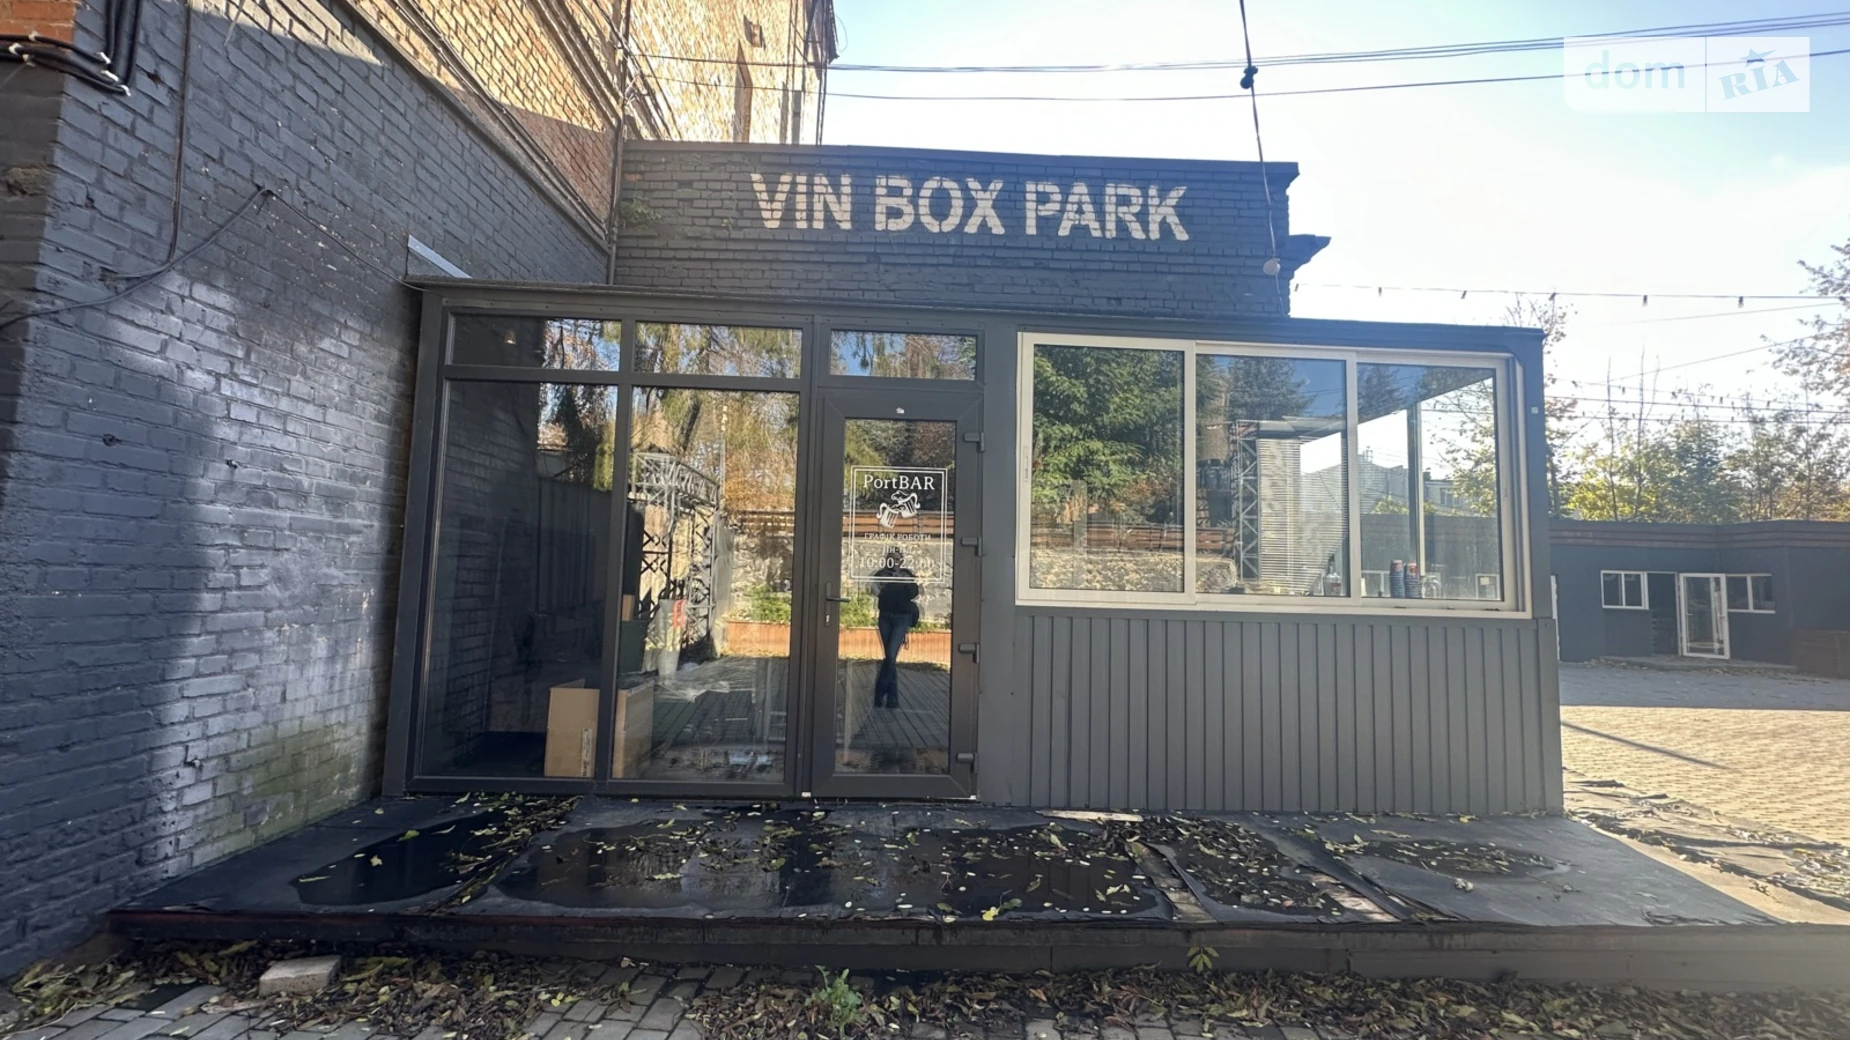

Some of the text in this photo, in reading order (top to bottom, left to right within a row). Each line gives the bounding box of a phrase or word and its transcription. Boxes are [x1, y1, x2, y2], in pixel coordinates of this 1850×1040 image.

[750, 172, 1190, 242] VIN BOX PARK
[863, 474, 935, 490] PortBAR
[864, 532, 931, 541] ГРАФІК РОБОТИ
